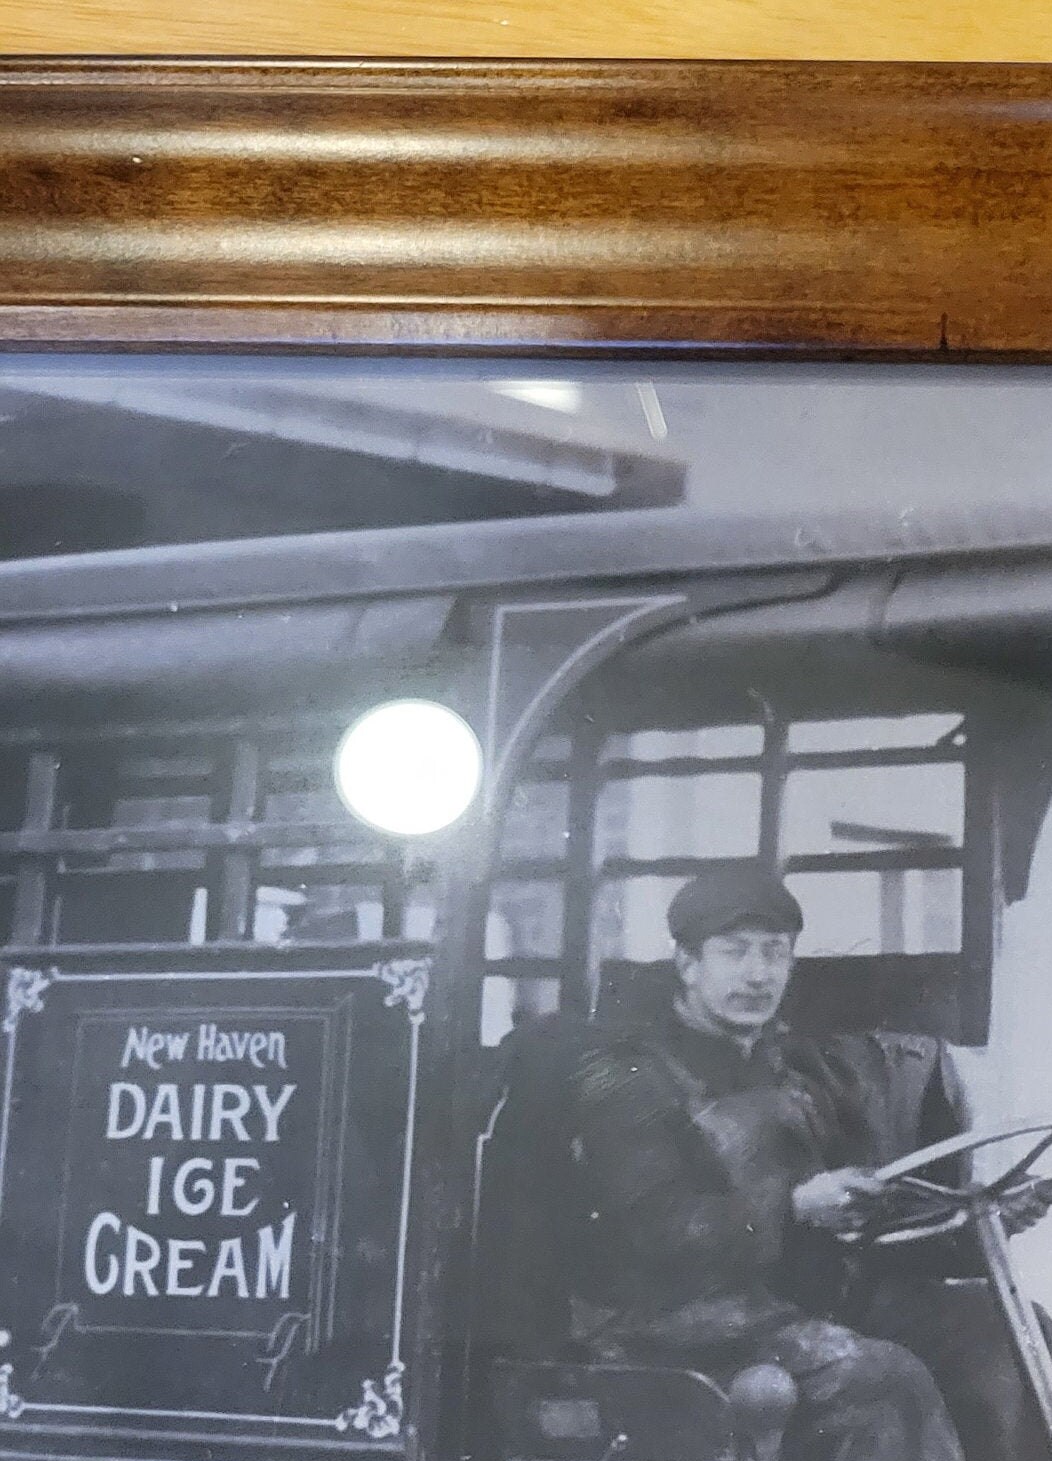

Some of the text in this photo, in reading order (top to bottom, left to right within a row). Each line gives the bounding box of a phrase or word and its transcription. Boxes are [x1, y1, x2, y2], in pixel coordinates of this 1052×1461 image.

[122, 1023, 287, 1069] New Haven
[106, 1082, 297, 1142] DAIRY
[85, 1211, 296, 1299] CREAM
